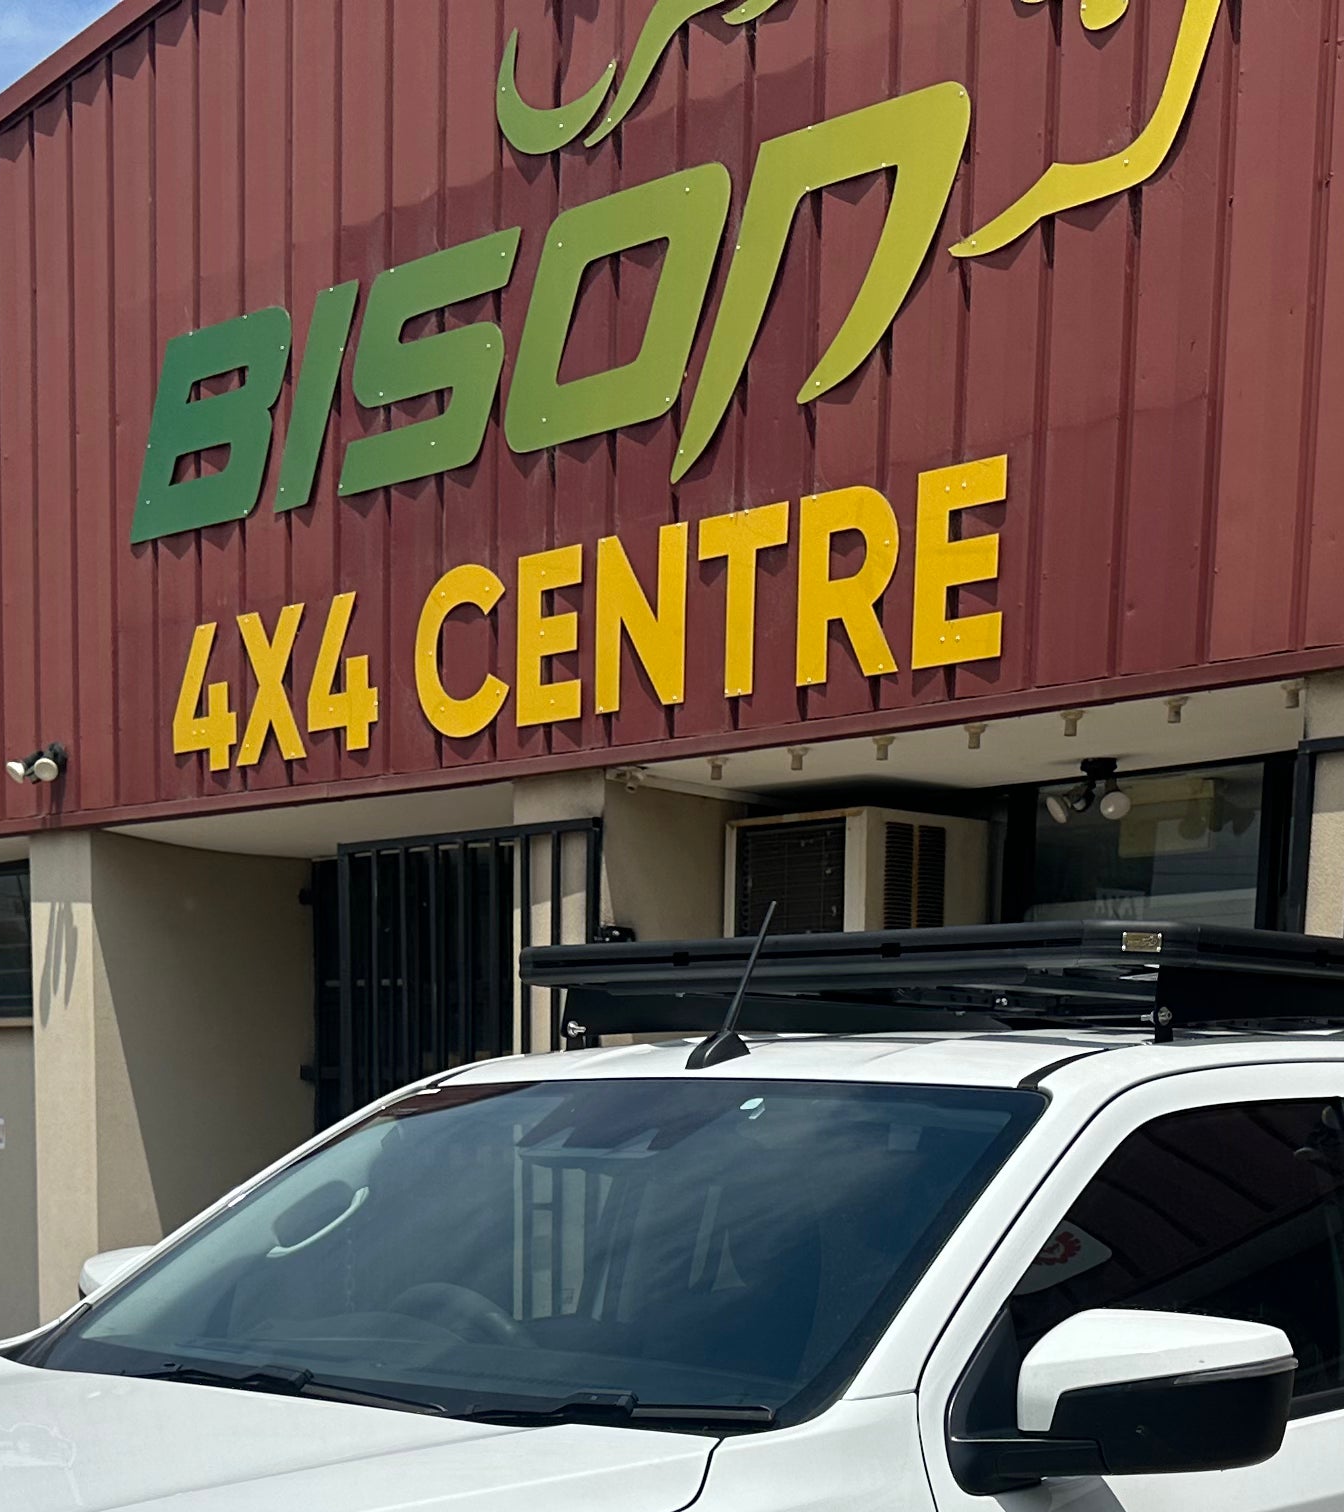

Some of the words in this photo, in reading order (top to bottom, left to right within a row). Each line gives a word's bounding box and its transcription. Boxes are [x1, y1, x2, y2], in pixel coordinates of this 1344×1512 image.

[130, 80, 971, 545] BISON
[172, 590, 379, 771] 4X4
[414, 453, 1007, 739] CENTRE
